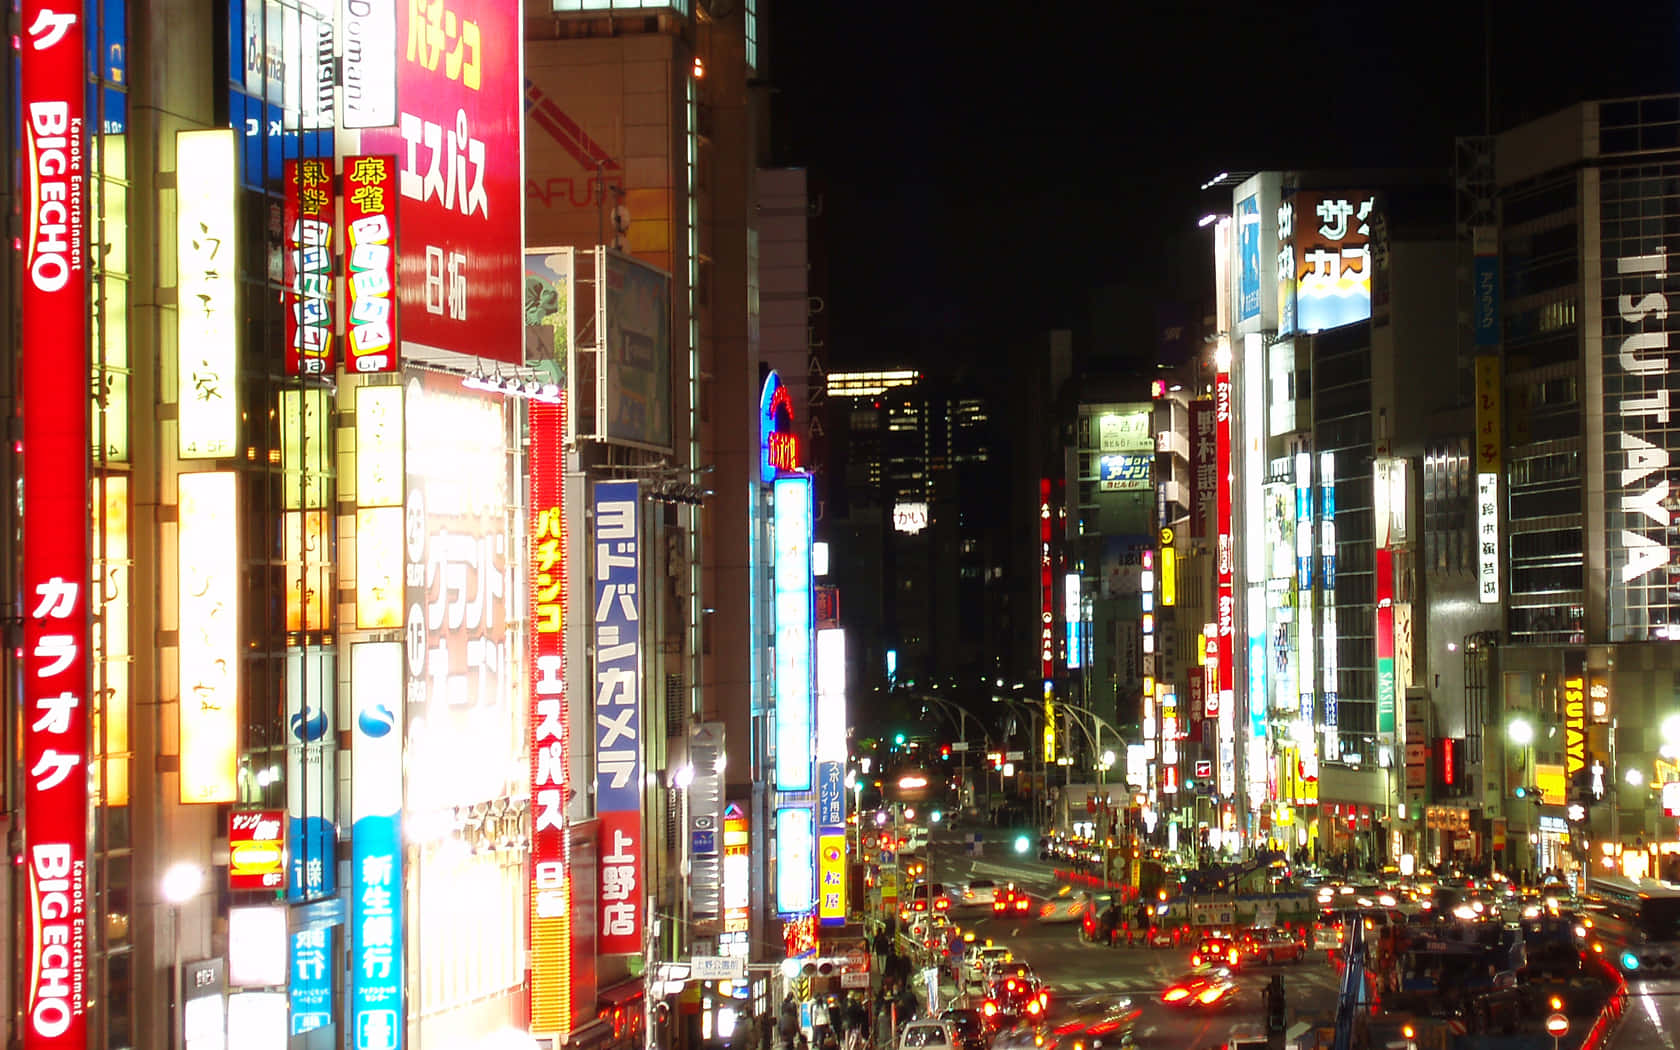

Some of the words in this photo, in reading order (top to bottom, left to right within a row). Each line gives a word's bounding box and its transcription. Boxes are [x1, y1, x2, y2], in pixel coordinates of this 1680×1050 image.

[30, 101, 69, 177] BIG
[71, 117, 81, 171] Karaoke
[350, 156, 388, 214] 麻雀
[400, 108, 488, 219] エスパス
[32, 181, 70, 292] ECHO
[71, 175, 82, 271] Entertainment
[425, 245, 467, 321] 日拓
[1617, 245, 1671, 584] TSUTAYA
[536, 506, 562, 633] パチンコ
[32, 577, 80, 791] カラオケ
[596, 501, 639, 789] ヨドバシカメラ
[535, 655, 564, 832] エスパス
[1565, 677, 1585, 774] TSUTAYA
[829, 762, 841, 824] スポーツ用品
[32, 843, 71, 920] BIG
[73, 860, 84, 914] Karaoke
[602, 829, 636, 937] 上野店
[33, 924, 71, 1038] ECHO
[73, 918, 85, 1016] Entertainment
